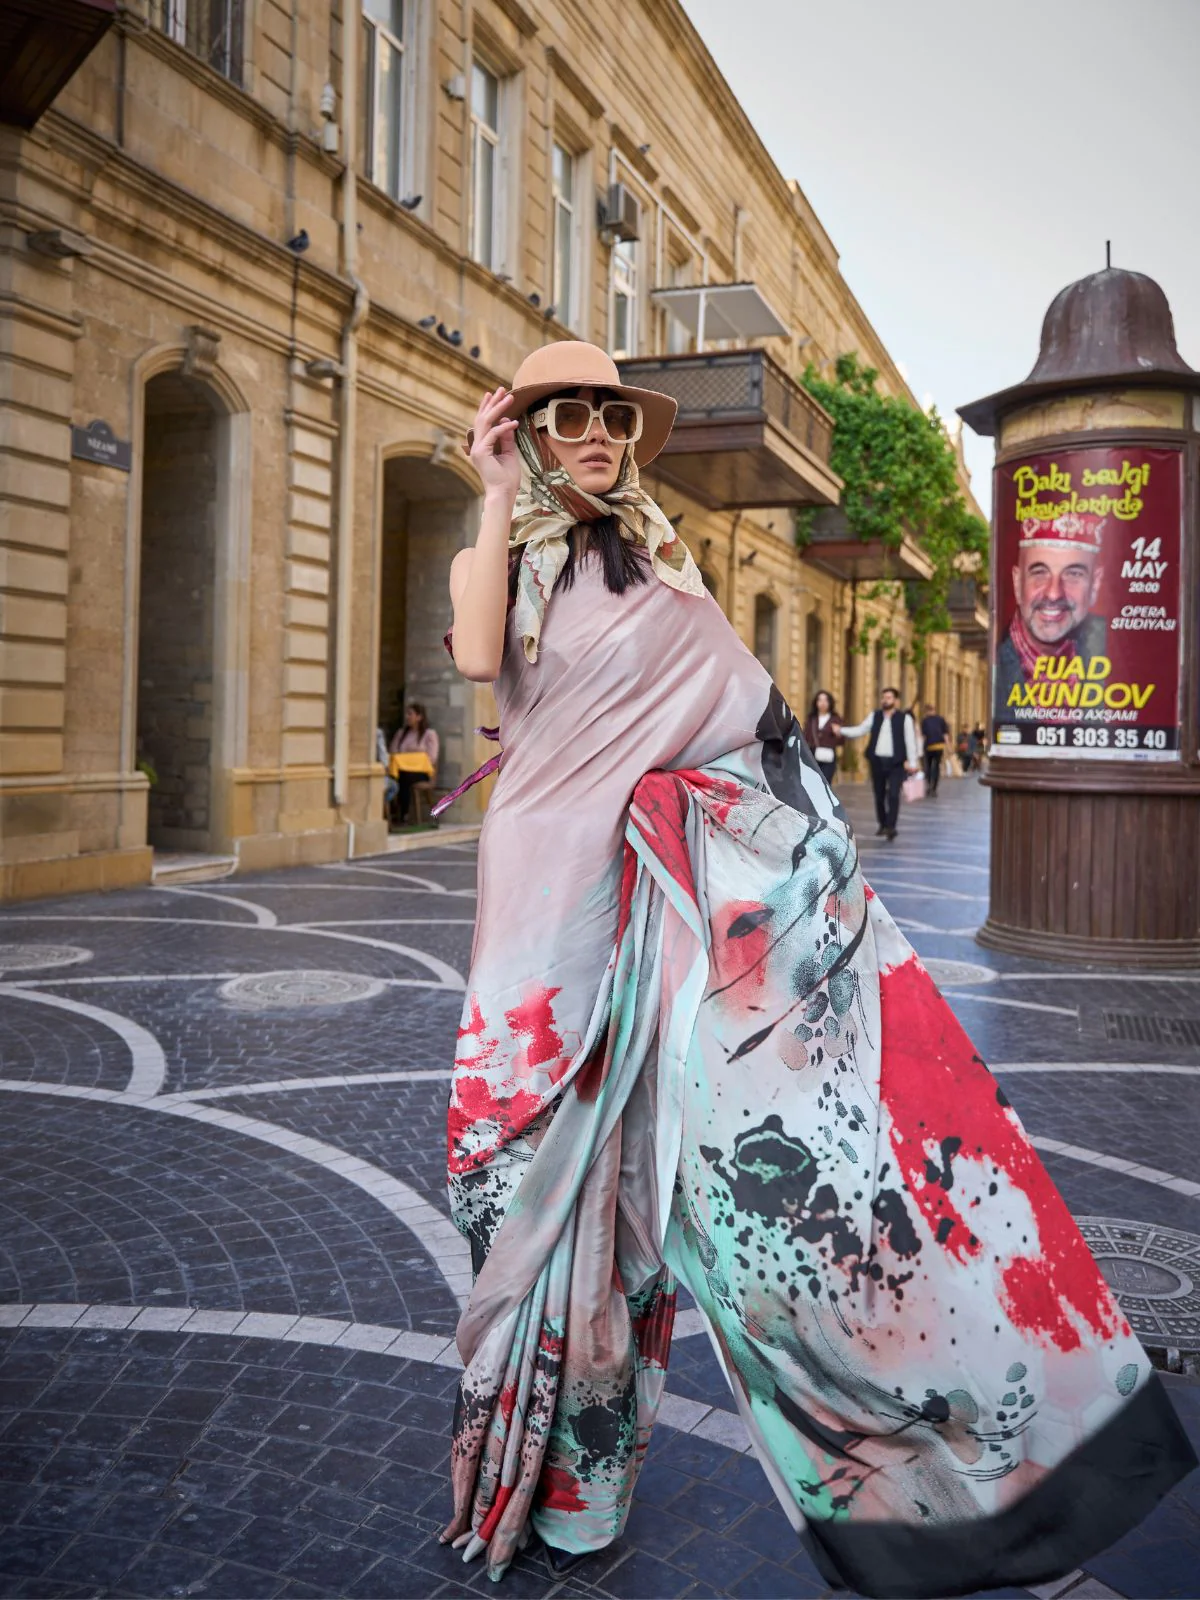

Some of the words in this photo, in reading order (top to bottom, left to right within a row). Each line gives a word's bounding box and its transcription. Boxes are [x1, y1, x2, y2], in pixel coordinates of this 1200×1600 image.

[1013, 463, 1072, 498] Bakı
[1081, 460, 1151, 495] sevgi
[1130, 537, 1162, 560] 14
[1121, 560, 1168, 579] MAY
[1128, 581, 1161, 593] 20:00
[1120, 605, 1167, 618] OPERA
[1033, 656, 1112, 680] FUAD
[1007, 682, 1156, 709] AXUNDOV
[1014, 707, 1083, 721] YARADICILIQ
[1036, 726, 1066, 746] 051
[1072, 727, 1109, 747] 303
[1114, 729, 1139, 748] 35
[1143, 729, 1166, 749] 40
